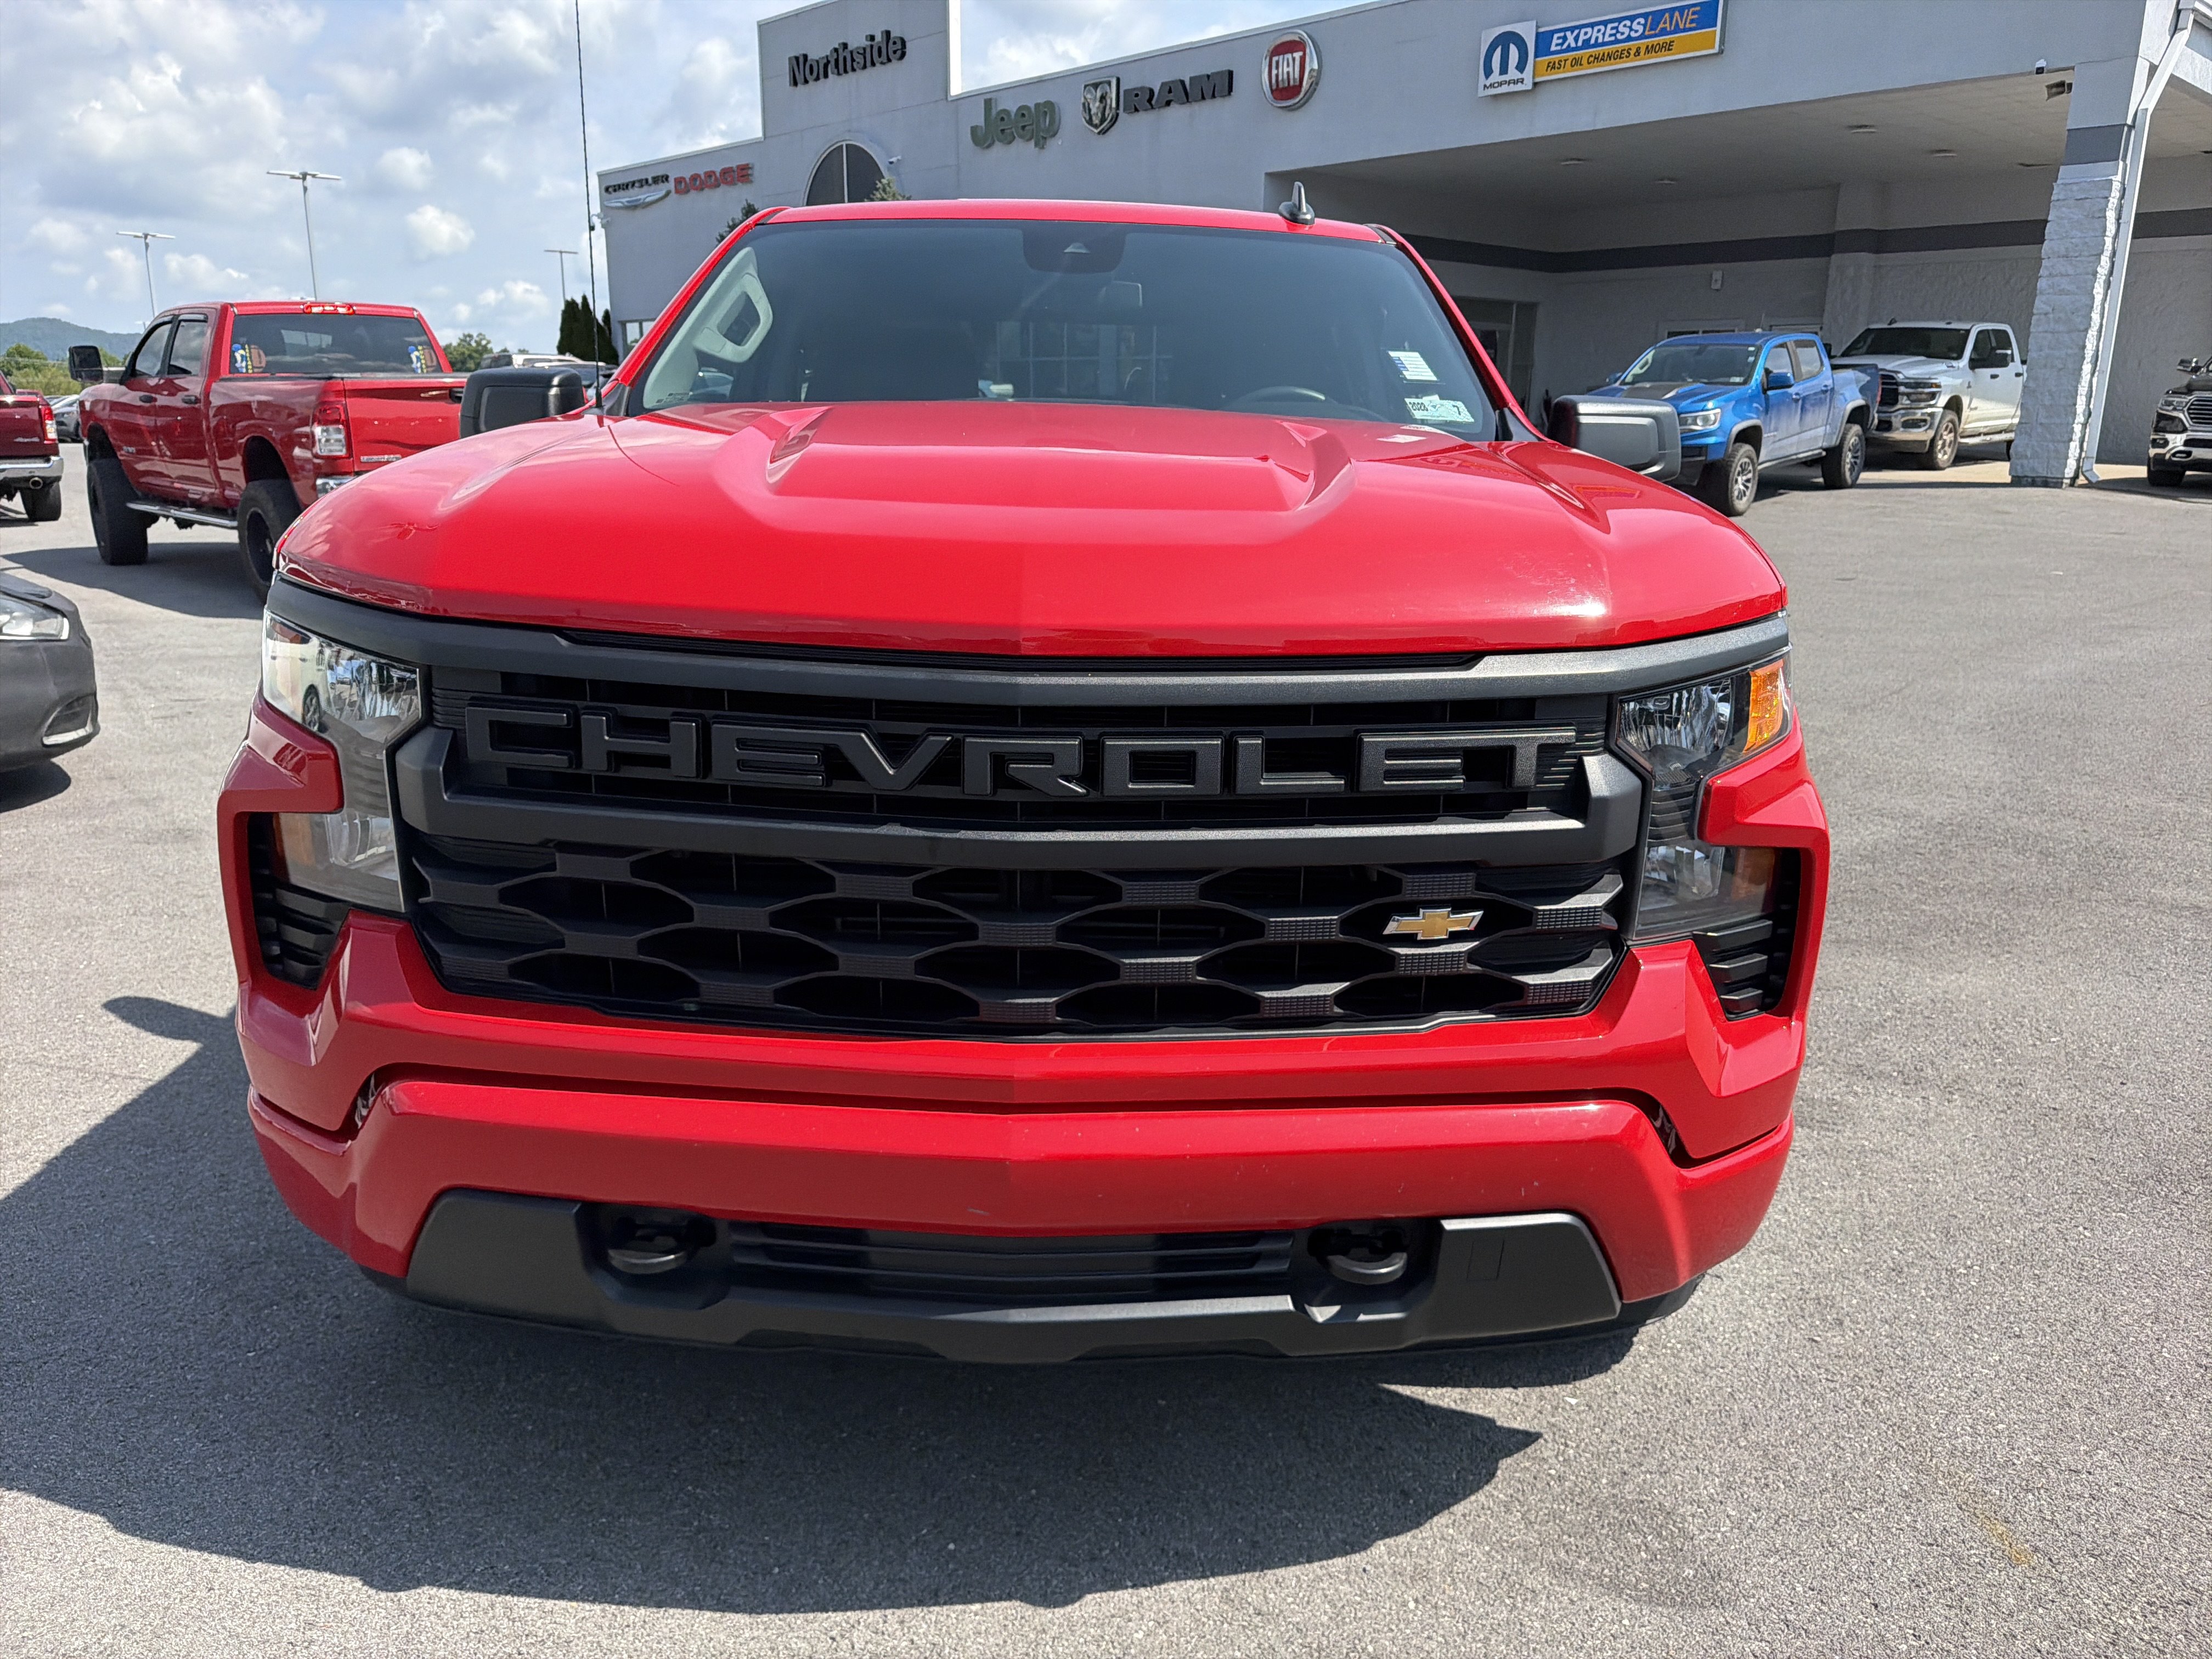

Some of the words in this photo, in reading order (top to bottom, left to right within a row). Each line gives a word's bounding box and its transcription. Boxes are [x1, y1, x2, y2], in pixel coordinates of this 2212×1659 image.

[788, 30, 906, 87] Northside
[1271, 50, 1304, 88] FIAT
[1546, 59, 1568, 72] FAST
[1570, 56, 1584, 68] OIL
[1587, 47, 1631, 65] CHANGES
[1634, 47, 1641, 58] &
[1644, 40, 1675, 55] MORE
[1124, 69, 1234, 114] RAM
[1483, 77, 1525, 91] MOPAR
[970, 97, 1060, 149] Jeep
[674, 162, 754, 195] DODGE
[466, 700, 1576, 797] CHEVROLET
